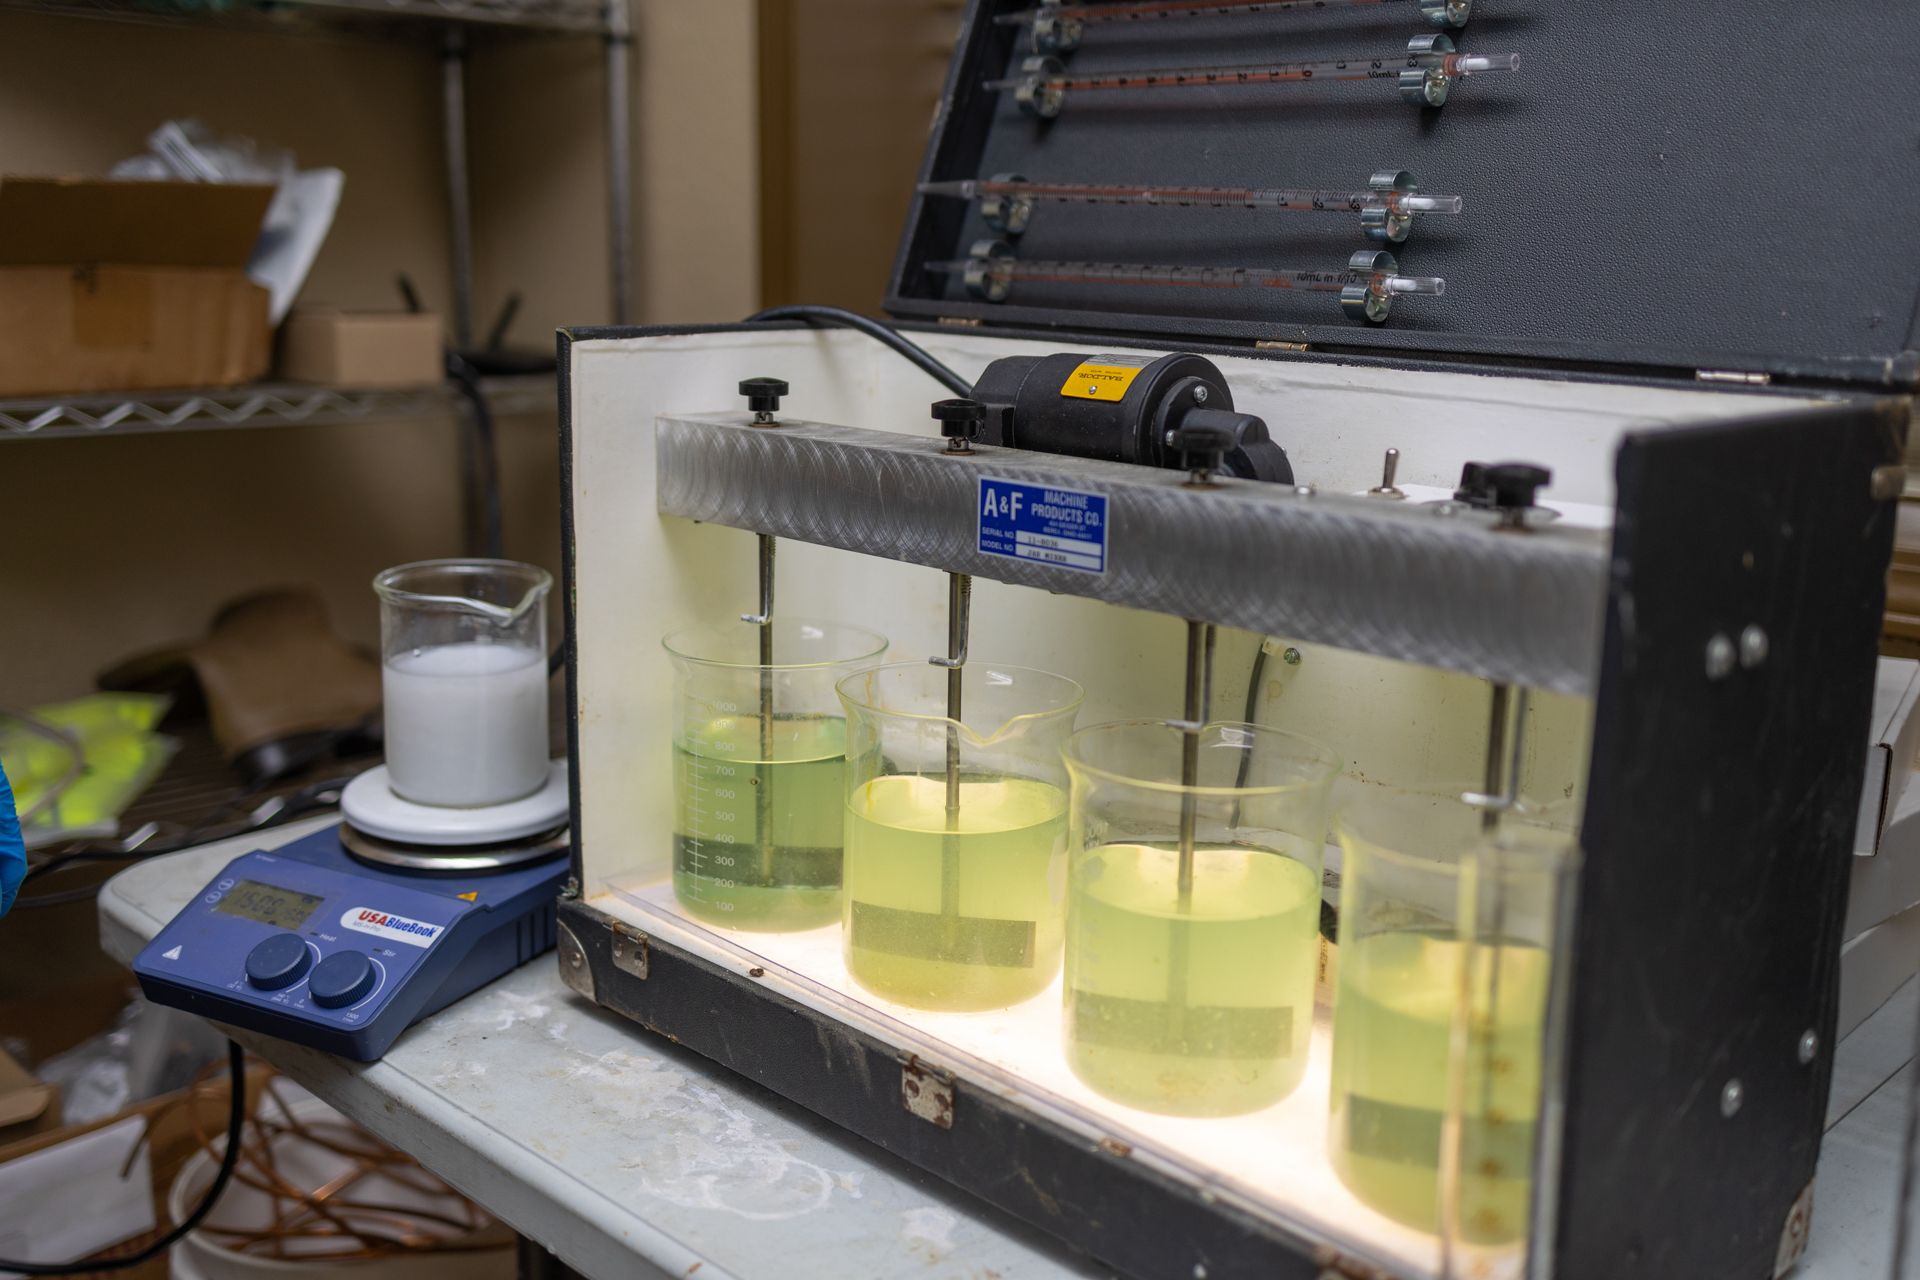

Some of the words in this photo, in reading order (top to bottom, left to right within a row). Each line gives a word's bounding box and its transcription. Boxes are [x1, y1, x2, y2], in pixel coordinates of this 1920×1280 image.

[983, 487, 1024, 521] A&F
[1044, 490, 1089, 509] MACHINE
[1031, 503, 1083, 524] PRODUCTS
[1084, 511, 1102, 527] CO.
[714, 741, 735, 752] 800
[714, 765, 735, 777] 700
[714, 811, 735, 823] 500
[714, 833, 735, 845] 400
[714, 856, 735, 867] 300
[714, 878, 735, 889] 200
[714, 901, 735, 912] 100
[358, 910, 437, 938] USABlueBook
